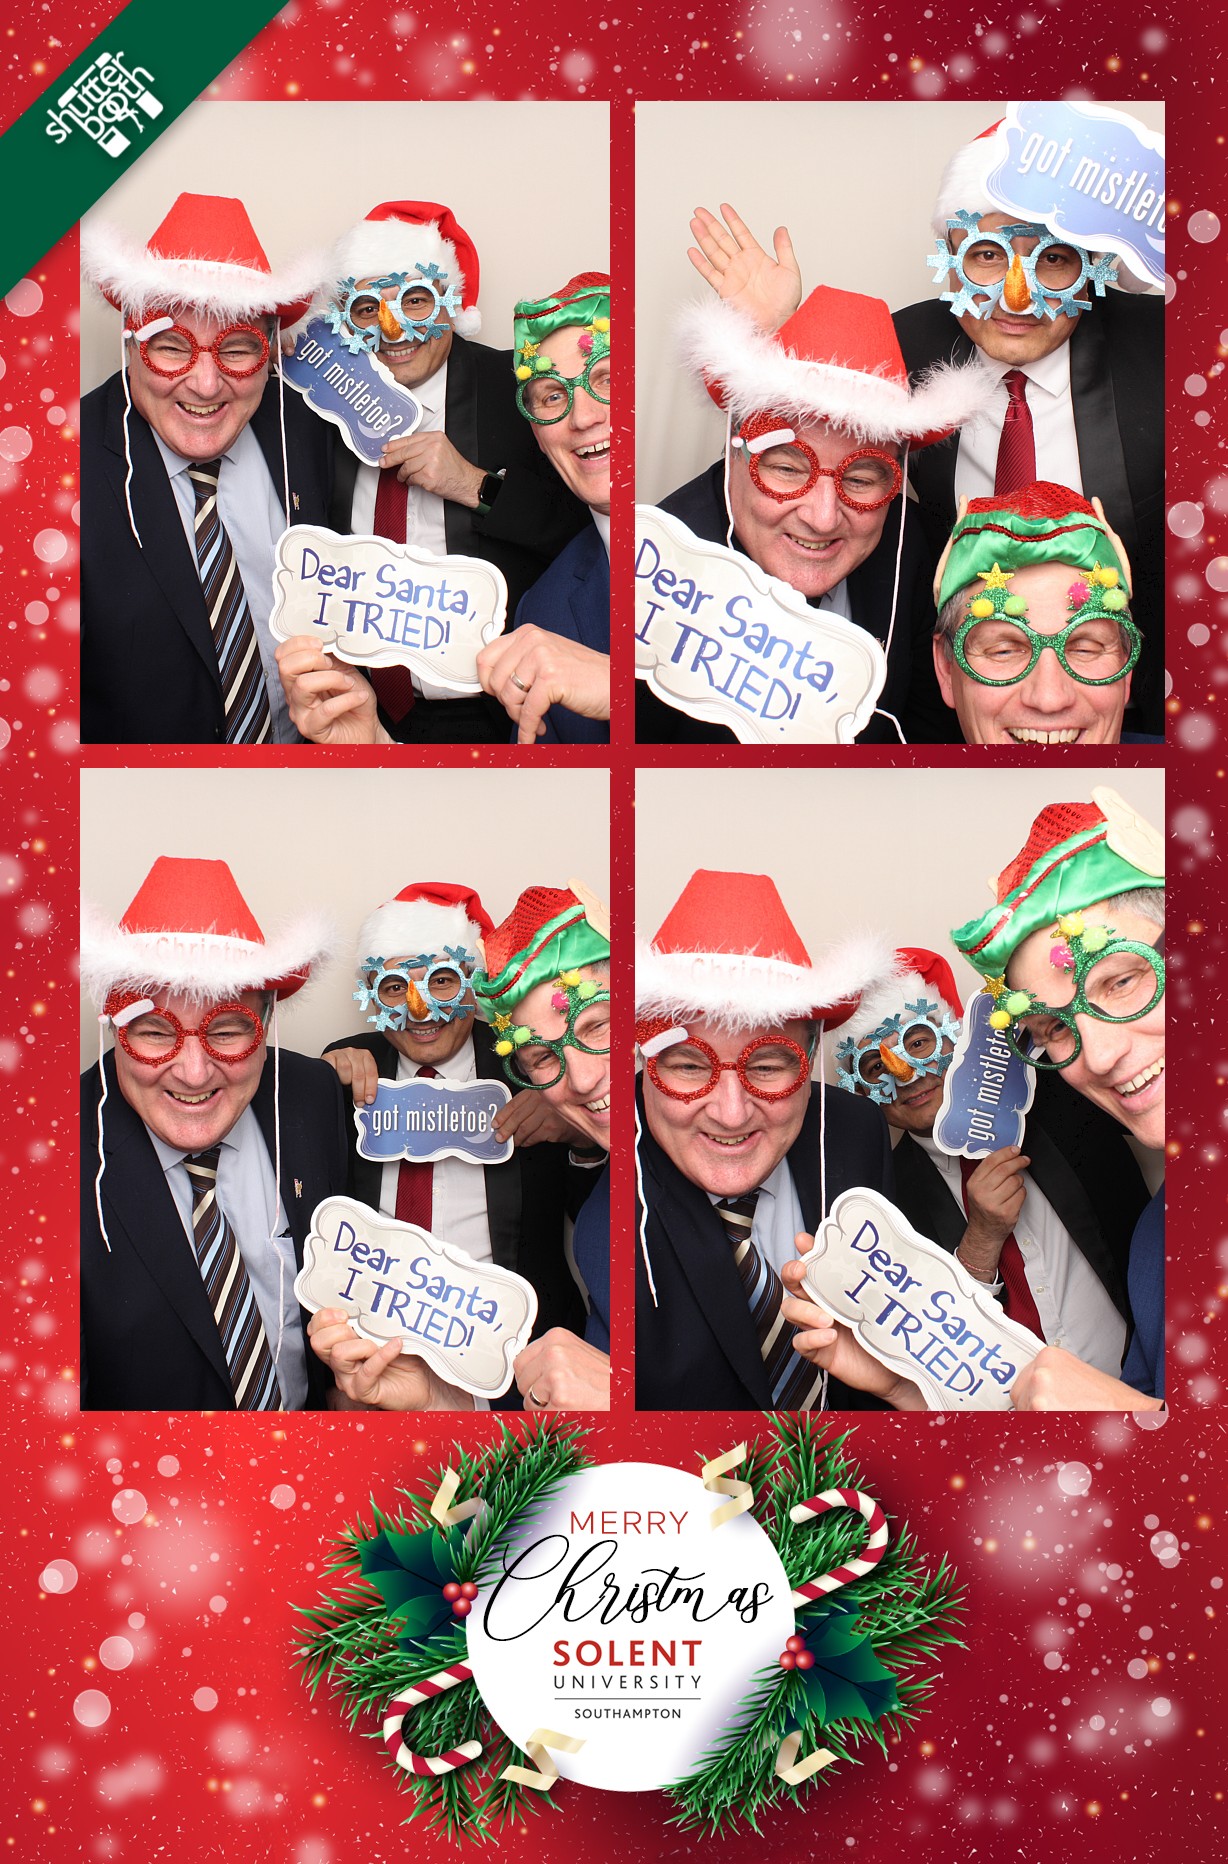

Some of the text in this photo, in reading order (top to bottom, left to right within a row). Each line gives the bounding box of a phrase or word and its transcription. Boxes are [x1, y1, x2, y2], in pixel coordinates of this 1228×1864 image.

[1017, 132, 1074, 178] got
[297, 340, 403, 437] got mistletoe?
[301, 548, 476, 622] Dear Santa,
[313, 592, 450, 654] I TRIED!
[635, 538, 838, 703] Dear Santa,
[635, 601, 801, 731] I TRIED!
[372, 1103, 498, 1136] got mistletoe?
[967, 1108, 995, 1141] got
[334, 1221, 502, 1332] Dear Santa,
[850, 1220, 922, 1293] Dear
[338, 1268, 474, 1355] I TRIED!
[844, 1270, 984, 1401] I TRIED!
